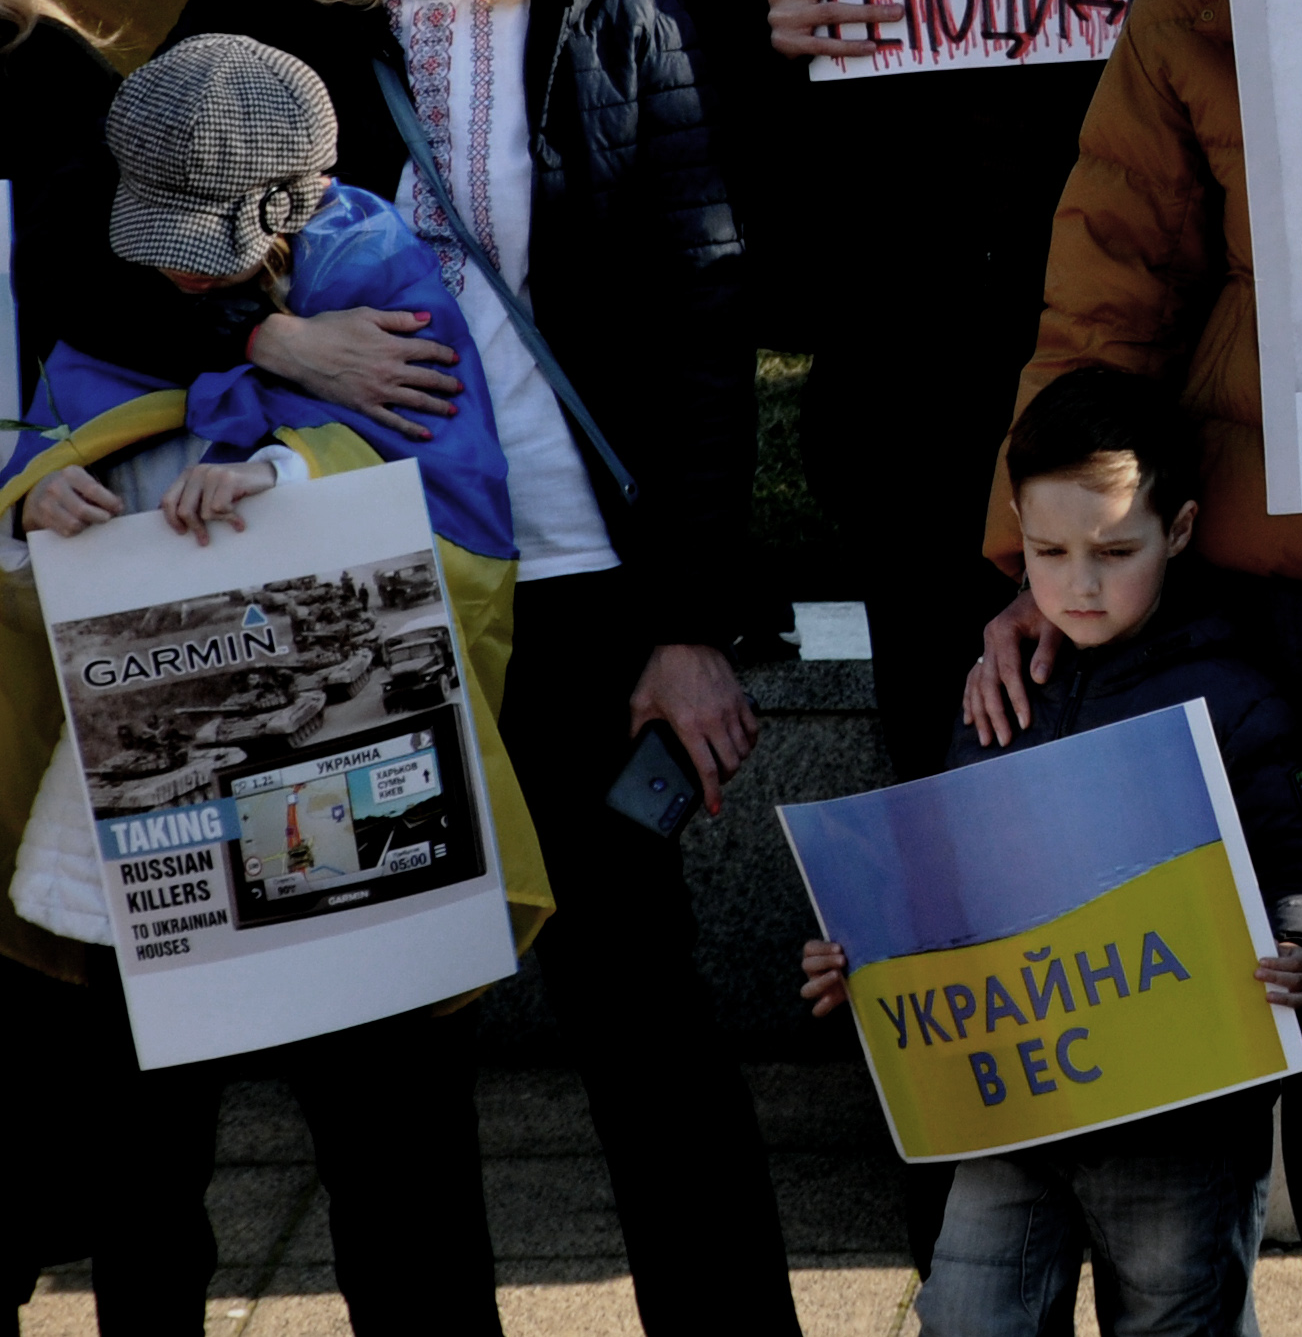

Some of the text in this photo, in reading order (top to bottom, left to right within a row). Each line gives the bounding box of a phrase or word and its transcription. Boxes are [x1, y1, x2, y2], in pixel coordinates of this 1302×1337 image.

[82, 626, 278, 690] GARMIN
[316, 747, 382, 775] УКРАИНА
[110, 806, 223, 855] TAKING
[120, 849, 214, 885] RUSSIAN
[390, 852, 427, 873] 05:00
[126, 880, 211, 914] KILLERS
[131, 909, 228, 940] TO UKRAINIAN
[136, 937, 191, 961] HOUSES
[877, 930, 1192, 1049] УКРАЙНА
